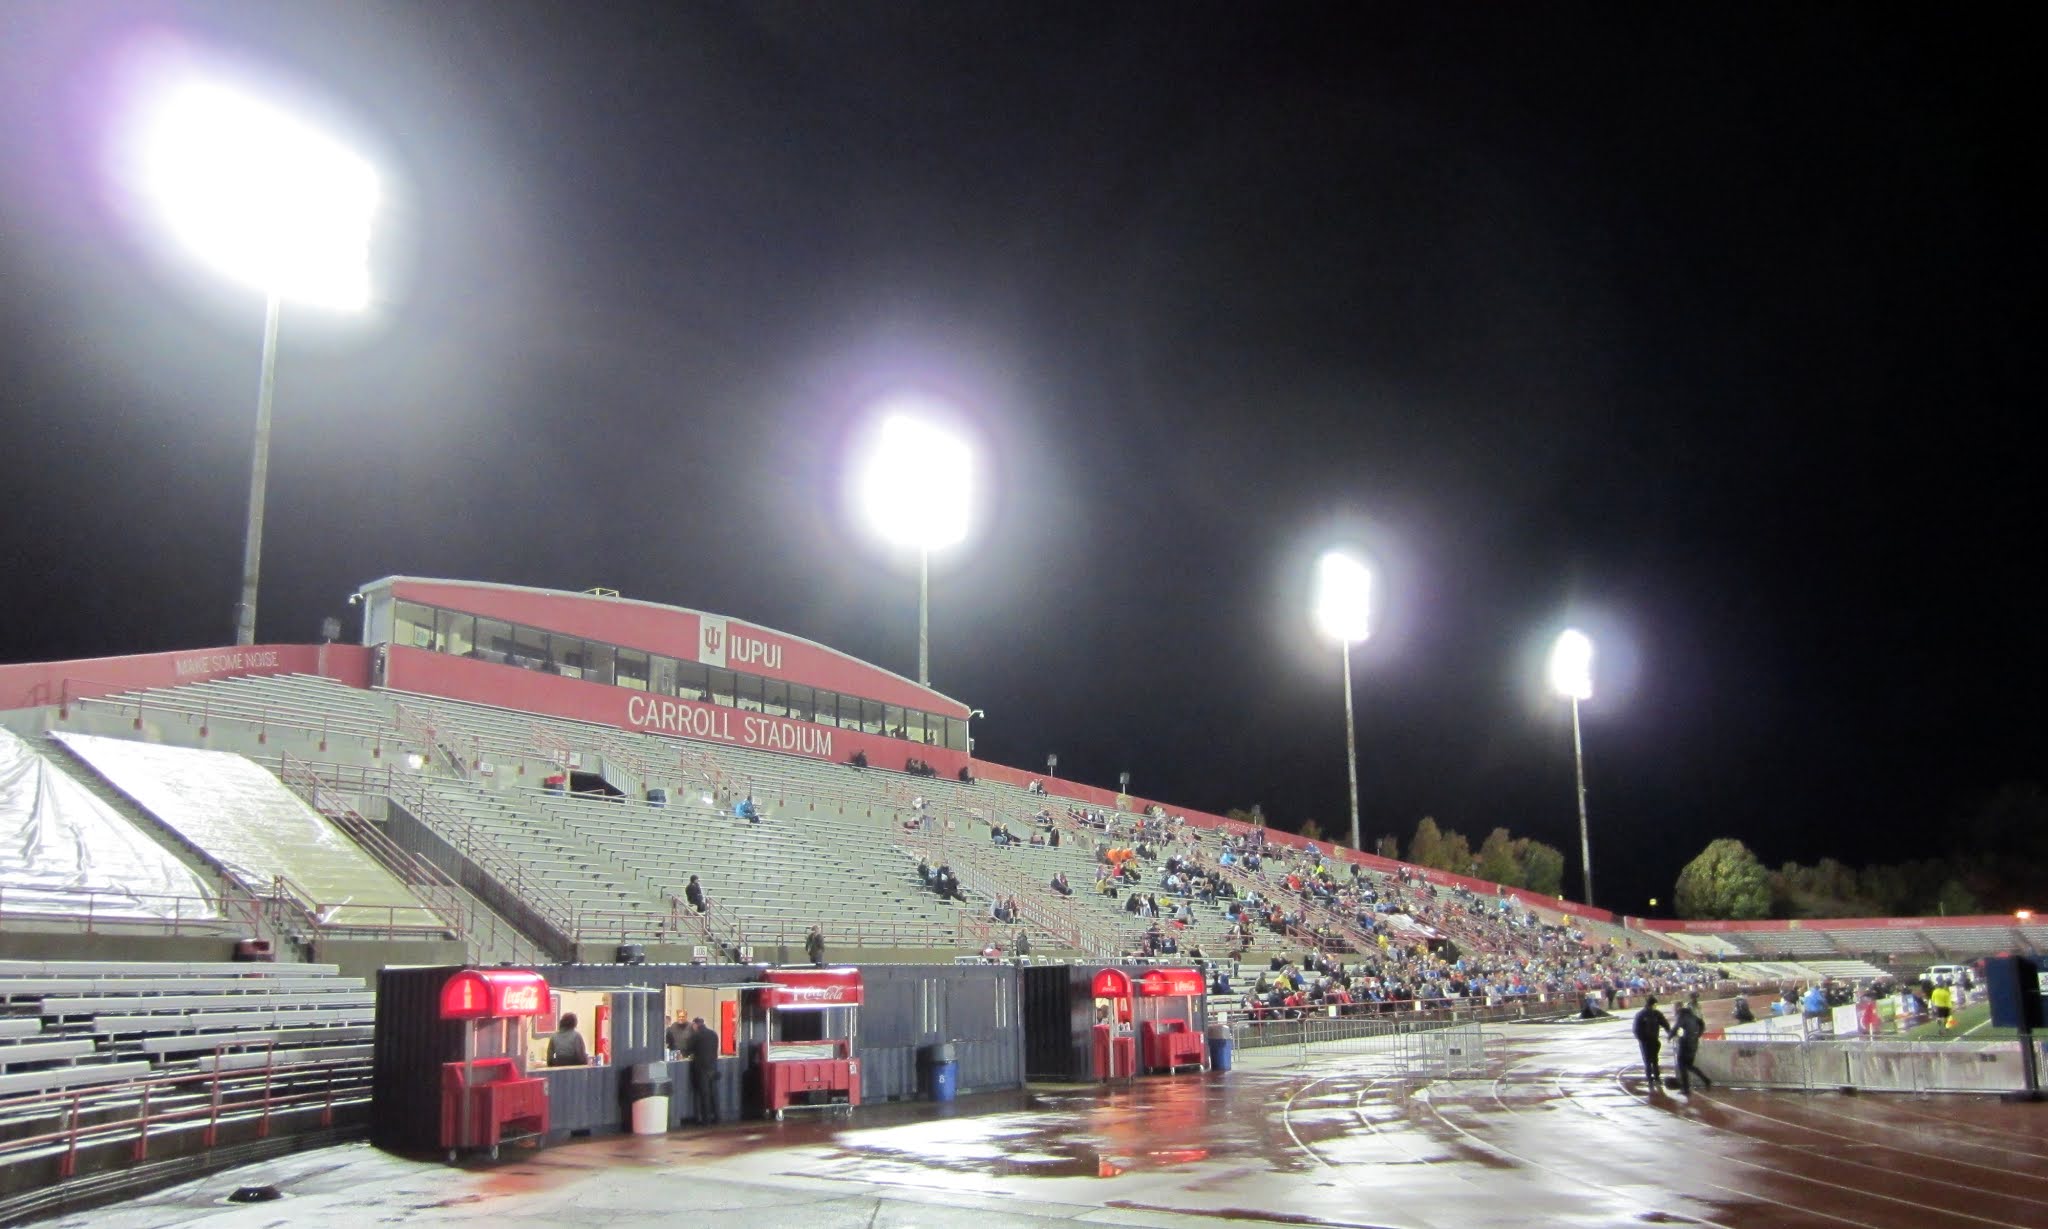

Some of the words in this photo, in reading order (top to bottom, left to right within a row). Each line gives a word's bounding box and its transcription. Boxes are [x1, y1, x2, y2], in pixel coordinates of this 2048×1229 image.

[176, 656, 210, 676] MAKE
[212, 653, 243, 672] SOME
[245, 651, 280, 668] NOISE
[731, 635, 782, 669] IUPUI
[628, 695, 736, 741] CARROLL
[743, 716, 832, 756] STADIUM
